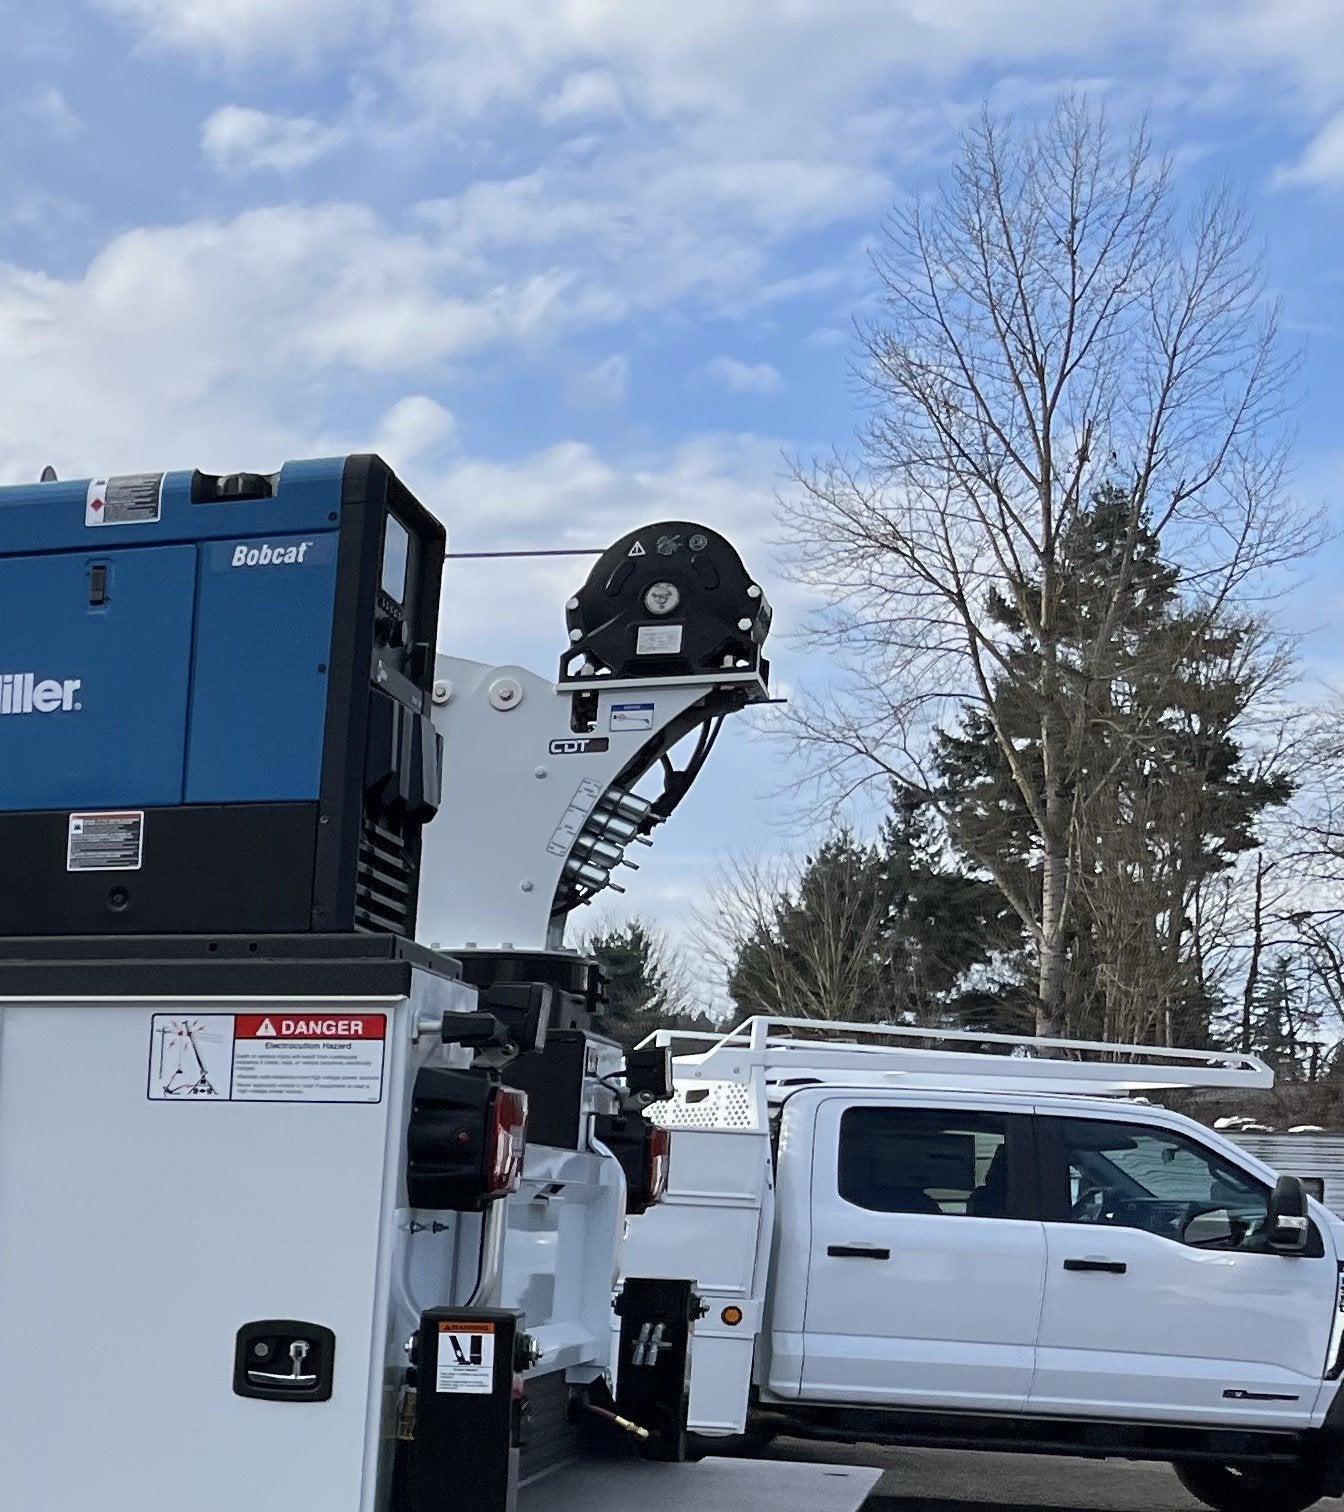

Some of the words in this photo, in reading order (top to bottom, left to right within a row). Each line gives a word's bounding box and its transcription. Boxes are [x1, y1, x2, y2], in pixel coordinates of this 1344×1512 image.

[550, 738, 590, 754] CDT
[281, 1020, 363, 1035] DANGER
[264, 1042, 320, 1050] Electrocution
[322, 1042, 352, 1050] Hazard
